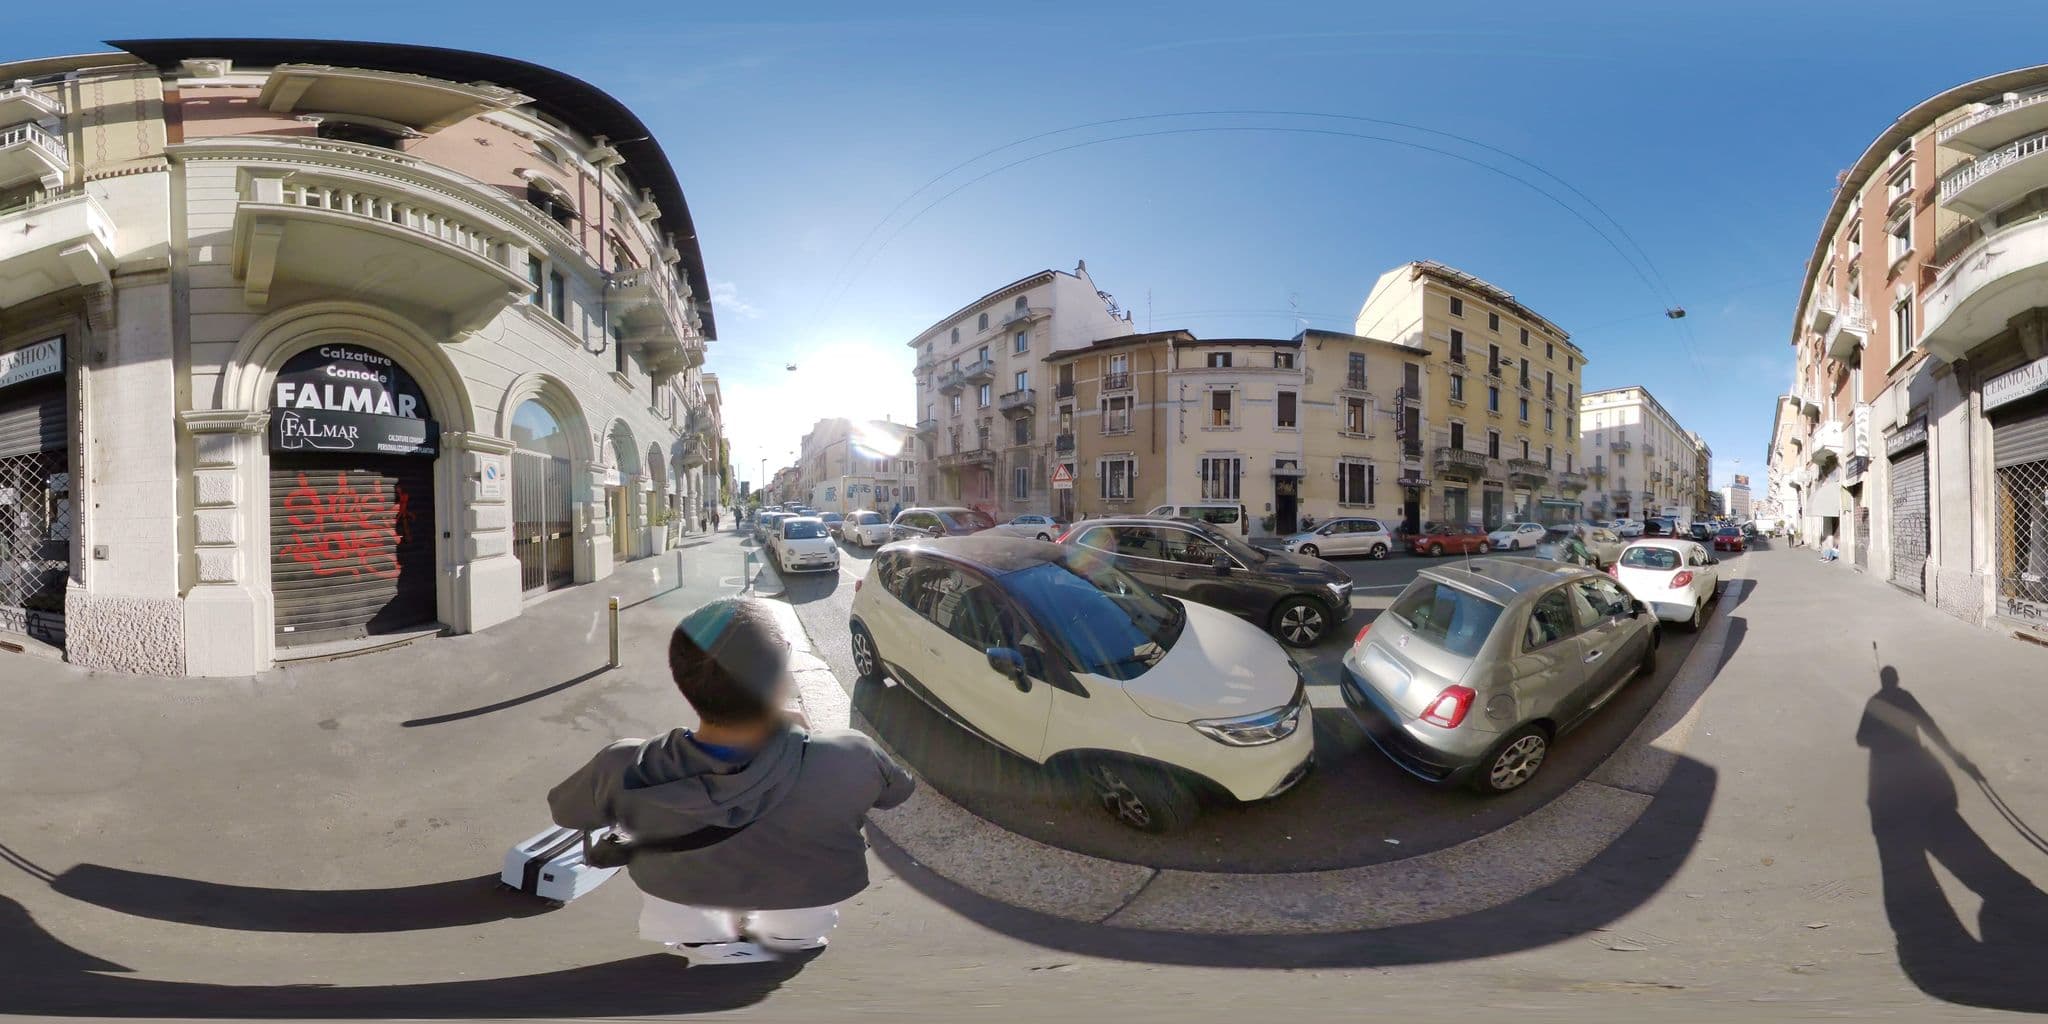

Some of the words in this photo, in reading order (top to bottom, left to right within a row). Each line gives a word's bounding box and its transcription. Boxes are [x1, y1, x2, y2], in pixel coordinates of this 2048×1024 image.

[320, 347, 392, 367] Calzature
[326, 365, 387, 383] Comode
[1985, 362, 2043, 397] CERIMONIA
[276, 382, 417, 419] FALMAR
